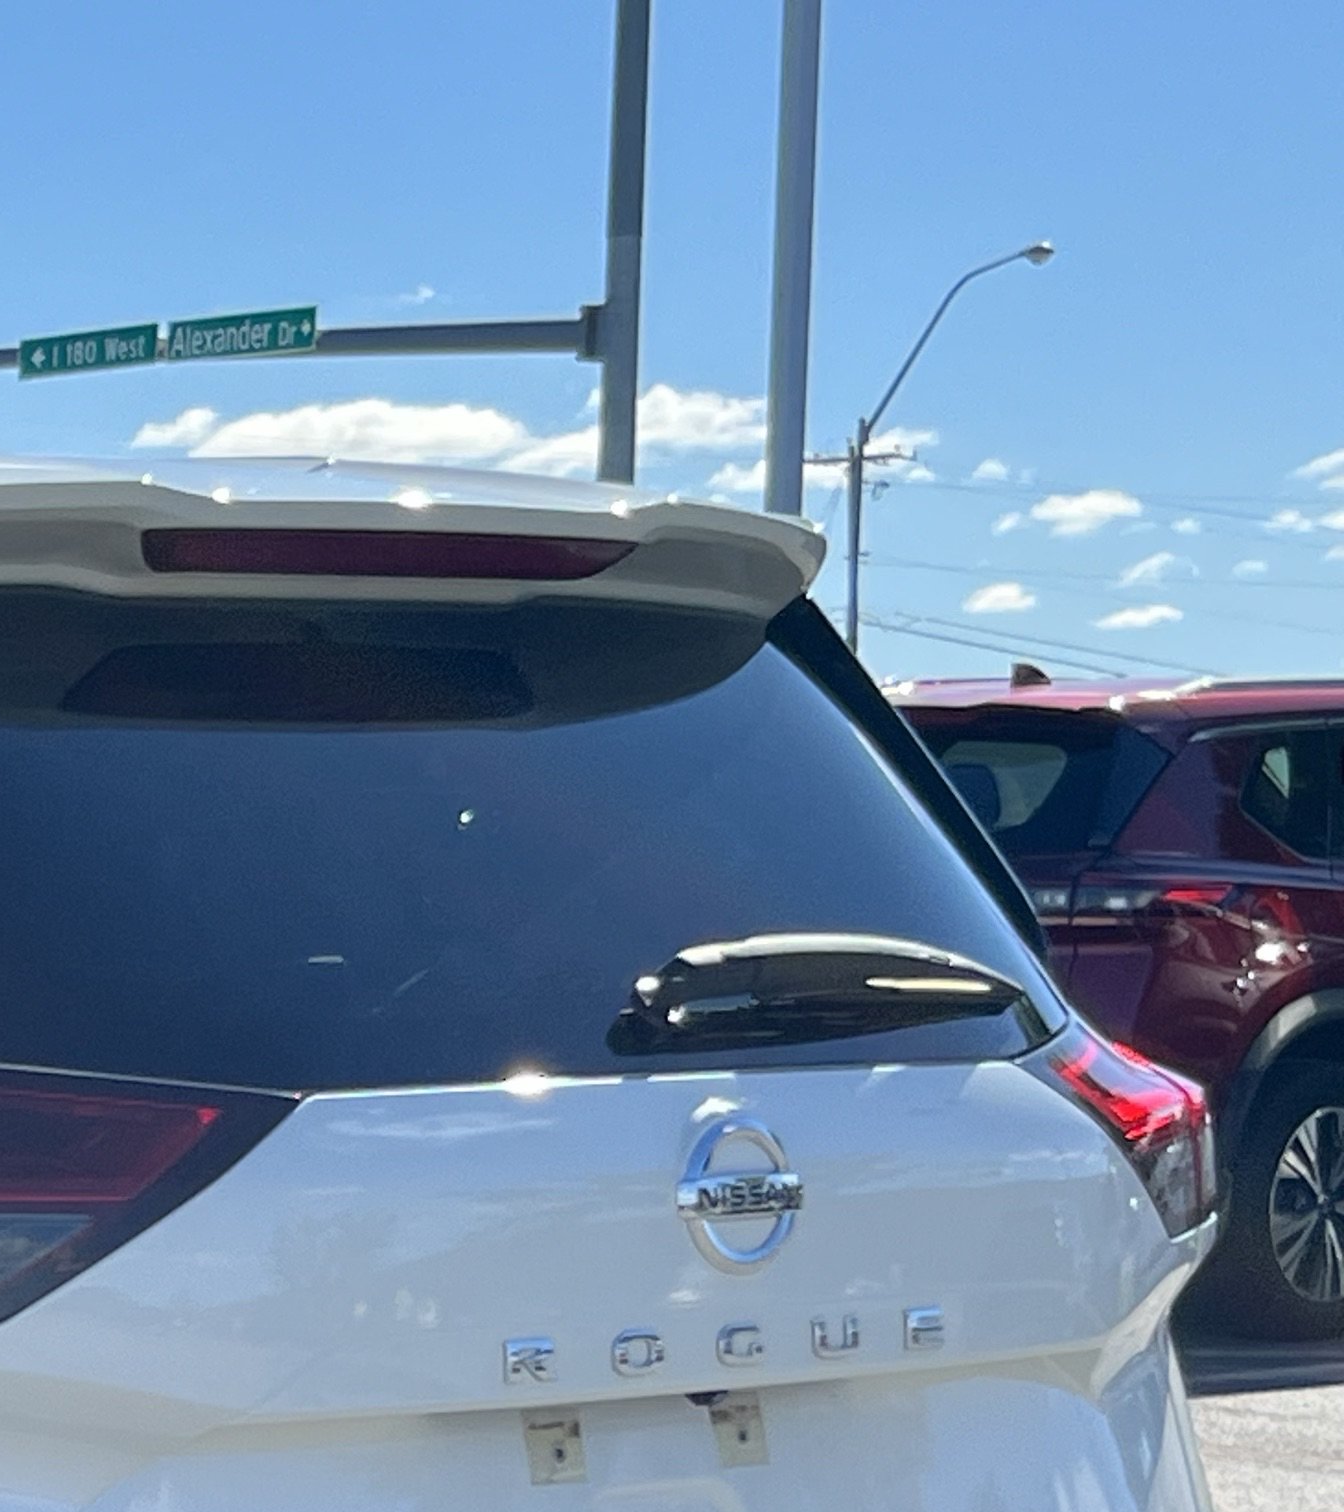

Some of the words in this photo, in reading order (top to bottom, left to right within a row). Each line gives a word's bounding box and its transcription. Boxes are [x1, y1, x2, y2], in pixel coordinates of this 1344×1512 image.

[66, 340, 98, 367] 180
[104, 335, 146, 362] West
[170, 319, 273, 357] Alexander
[277, 320, 297, 346] Dr
[697, 1181, 804, 1210] NISSAN
[502, 1304, 946, 1384] ROGUE
